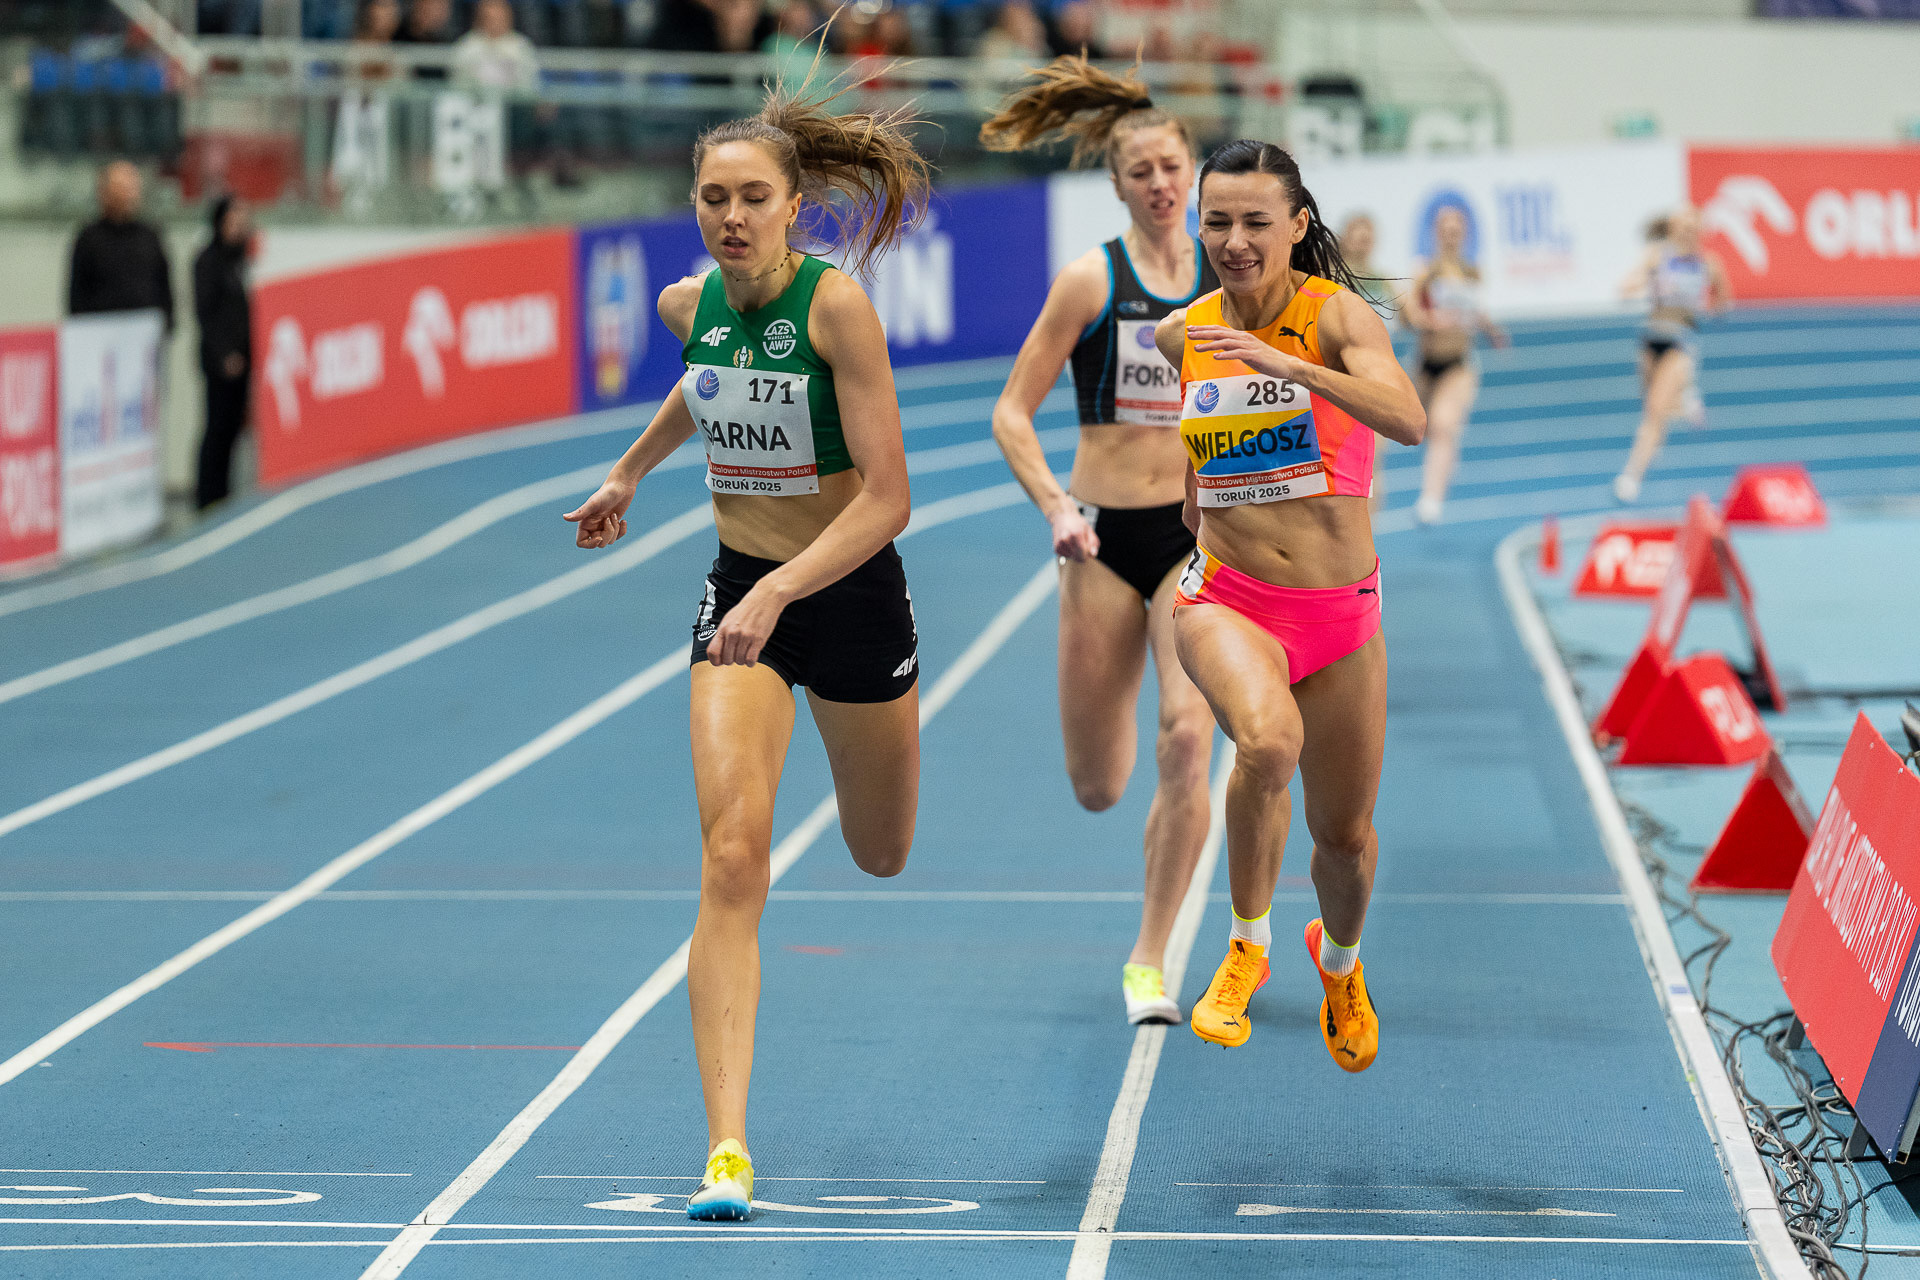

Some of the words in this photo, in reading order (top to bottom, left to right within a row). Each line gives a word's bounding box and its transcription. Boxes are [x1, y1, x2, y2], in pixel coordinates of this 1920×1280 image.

[1803, 187, 1920, 261] ORL
[701, 326, 732, 347] 4F
[770, 325, 790, 336] AZS
[769, 340, 790, 351] AWF
[748, 378, 795, 404] 171
[1246, 380, 1296, 407] 285
[700, 418, 793, 451] SARNA
[1185, 423, 1311, 460] WIELGOSZ
[712, 465, 739, 475] Halowe
[739, 466, 786, 477] Mistrzostwa
[787, 466, 811, 477] Polski
[1216, 478, 1244, 487] Halowe
[1245, 471, 1293, 484] Mistrzostwa
[1294, 463, 1319, 476] Polski
[711, 478, 749, 491] TORUŃ
[751, 481, 782, 492] 2025
[1215, 487, 1256, 502] TORUŃ
[1258, 485, 1291, 498] 2025
[1863, 880, 1918, 1002] POLSKI
